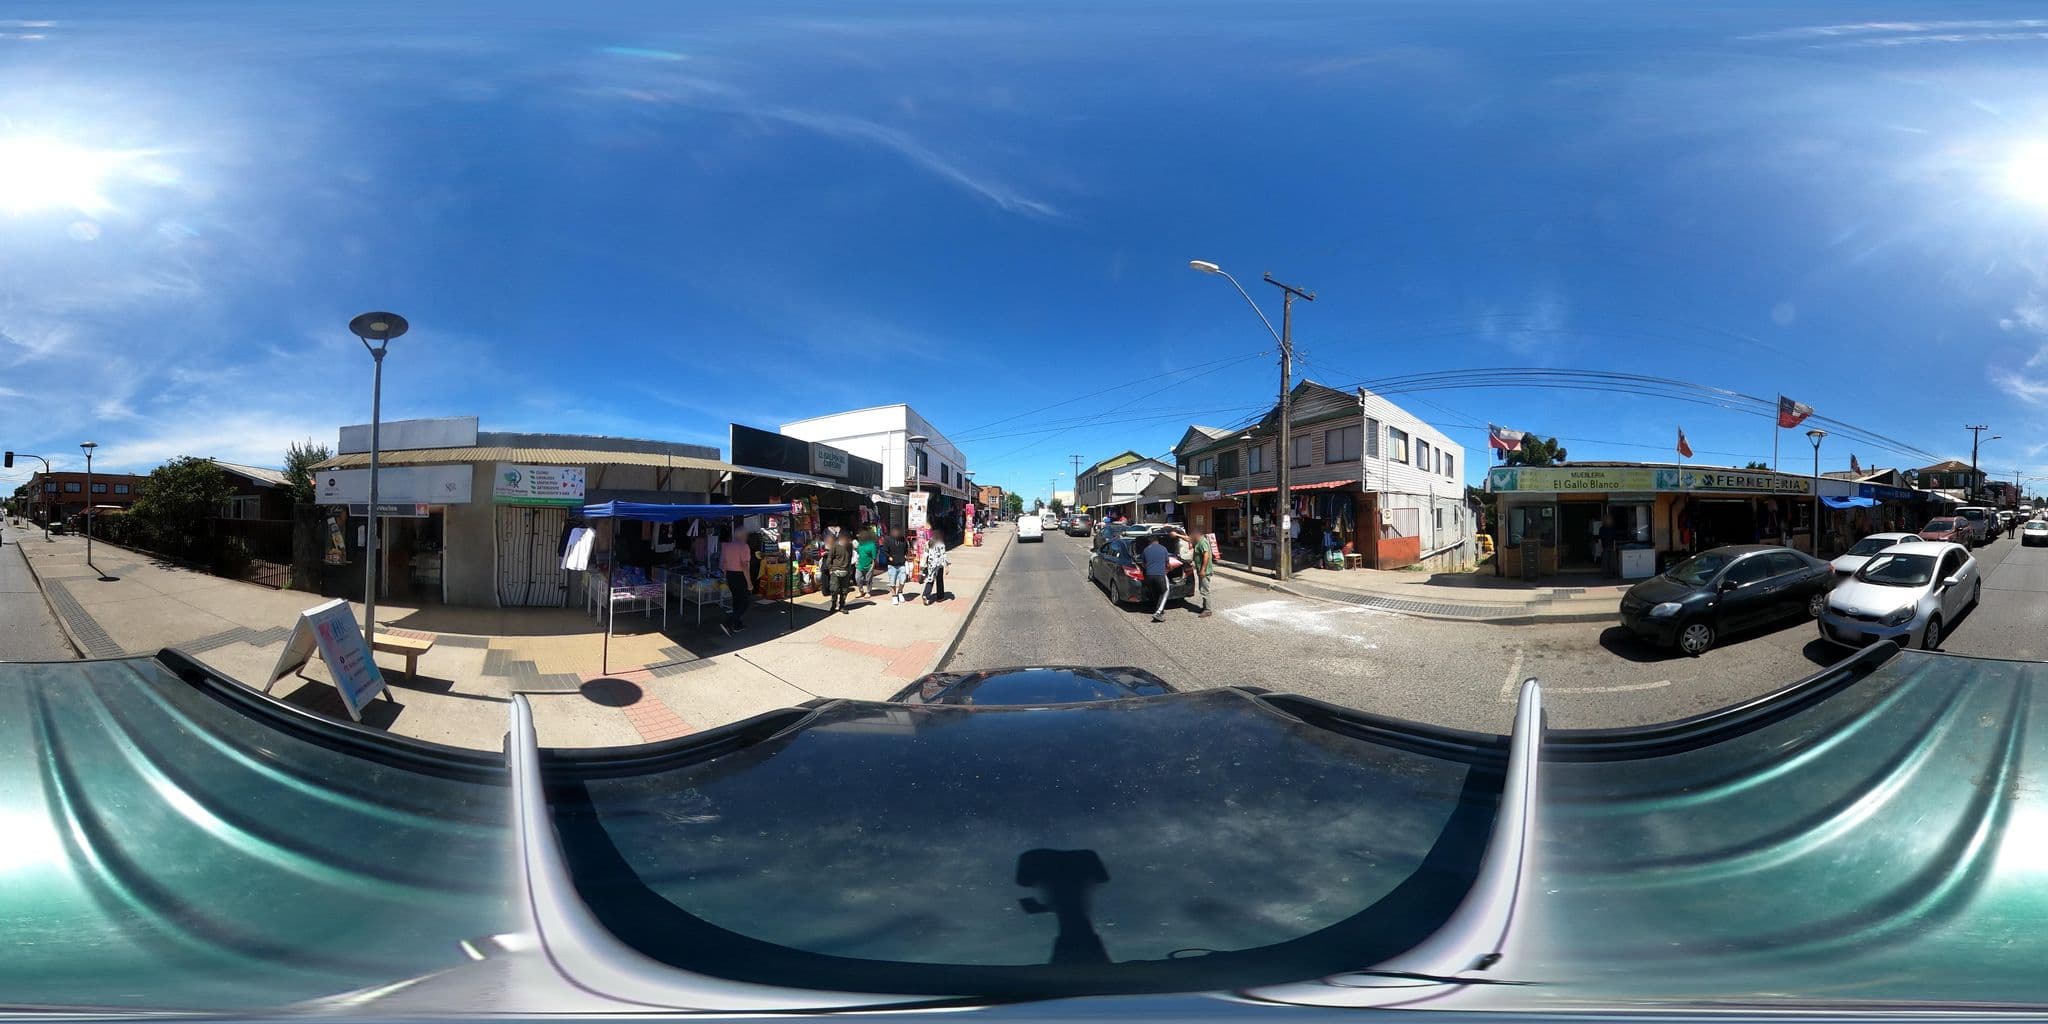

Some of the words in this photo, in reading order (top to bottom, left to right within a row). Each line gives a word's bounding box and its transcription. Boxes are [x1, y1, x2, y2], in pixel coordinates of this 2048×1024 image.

[1553, 480, 1562, 489] El
[1564, 480, 1588, 489] Gallo
[1590, 480, 1619, 489] Blanco
[1717, 475, 1800, 489] FERRETERIA
